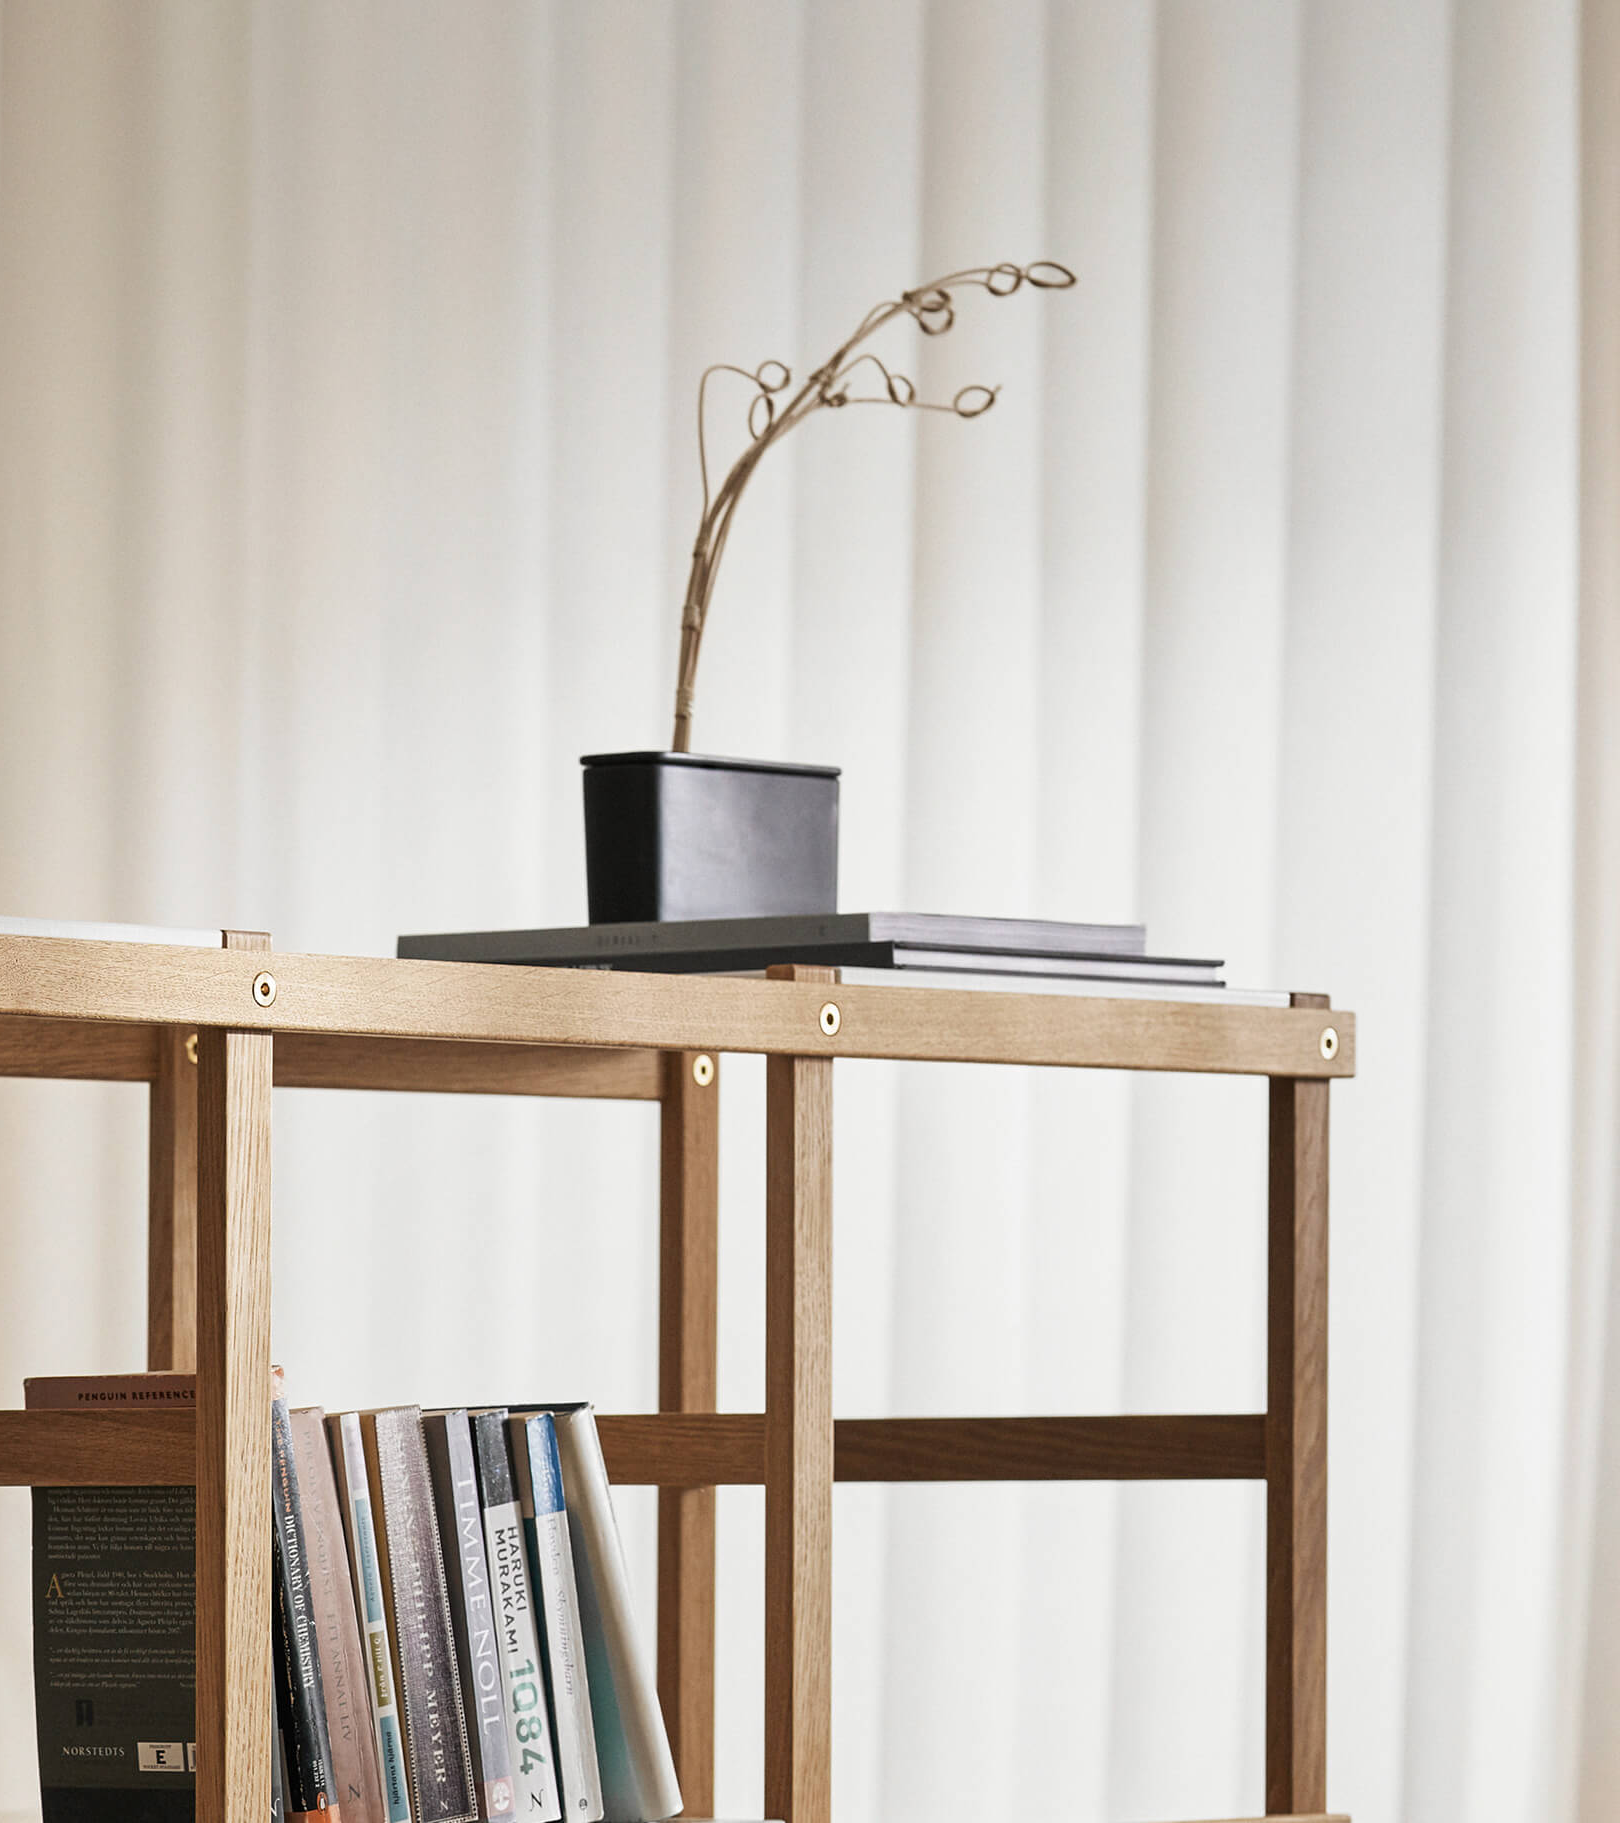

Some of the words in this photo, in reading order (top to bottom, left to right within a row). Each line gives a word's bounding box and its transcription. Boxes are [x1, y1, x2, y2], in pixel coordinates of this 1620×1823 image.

[77, 1391, 127, 1401] PENGUIN
[131, 1390, 196, 1401] REFERENCE
[279, 1449, 292, 1513] PENGUIN
[284, 1514, 303, 1592] DICTIONARY
[494, 1529, 519, 1655] MURAKAMI
[507, 1526, 528, 1612] HARUKI
[293, 1594, 306, 1611] OF
[457, 1466, 486, 1613] TIMME
[474, 1629, 500, 1736] NOLL
[296, 1615, 315, 1689] CHEMISTRY
[411, 1562, 434, 1678] PHILIPP
[426, 1689, 447, 1783] MEYER
[331, 1649, 347, 1706] ANNAT
[339, 1714, 351, 1741] LIV
[509, 1658, 547, 1776] 1Q84
[62, 1746, 126, 1757] NORSTEDTS
[155, 1750, 167, 1765] E
